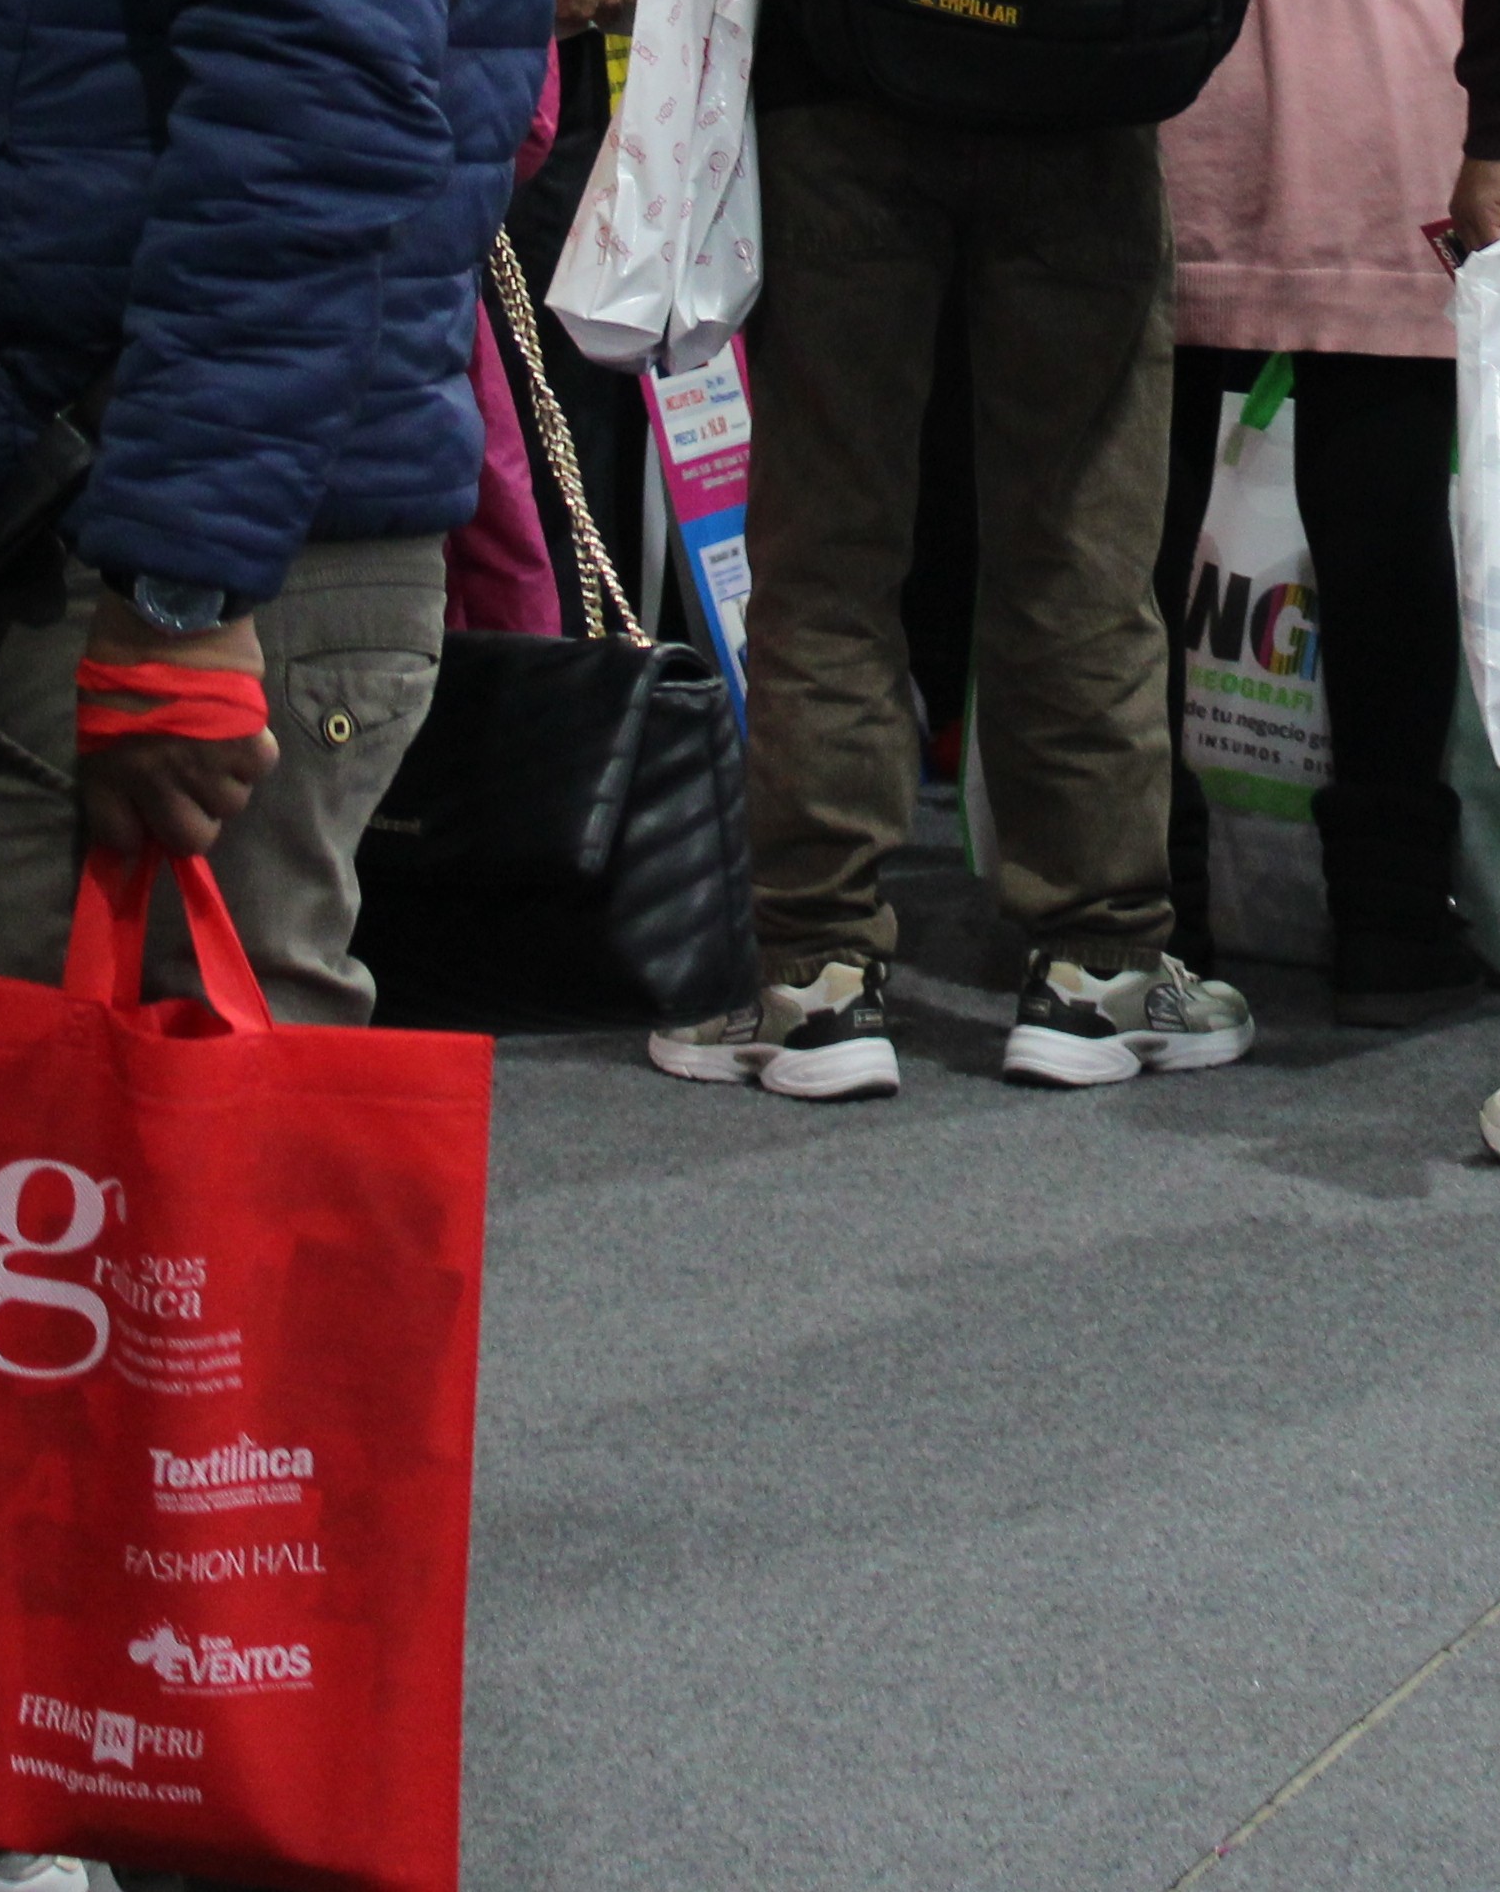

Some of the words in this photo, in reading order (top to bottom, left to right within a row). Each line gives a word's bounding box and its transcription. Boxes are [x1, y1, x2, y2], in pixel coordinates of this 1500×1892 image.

[1211, 706, 1232, 725] tu
[1236, 712, 1306, 743] negocio
[1198, 734, 1281, 764] INSUMOS
[140, 1256, 206, 1288] 2025
[149, 1440, 314, 1489] Textilinca
[124, 1545, 245, 1584] FASHION
[253, 1542, 327, 1575] HALL
[160, 1643, 312, 1686] EVENTOS
[18, 1692, 94, 1742] FERIAS
[136, 1722, 204, 1760] PERU
[10, 1753, 203, 1805] www.grafinca.com
